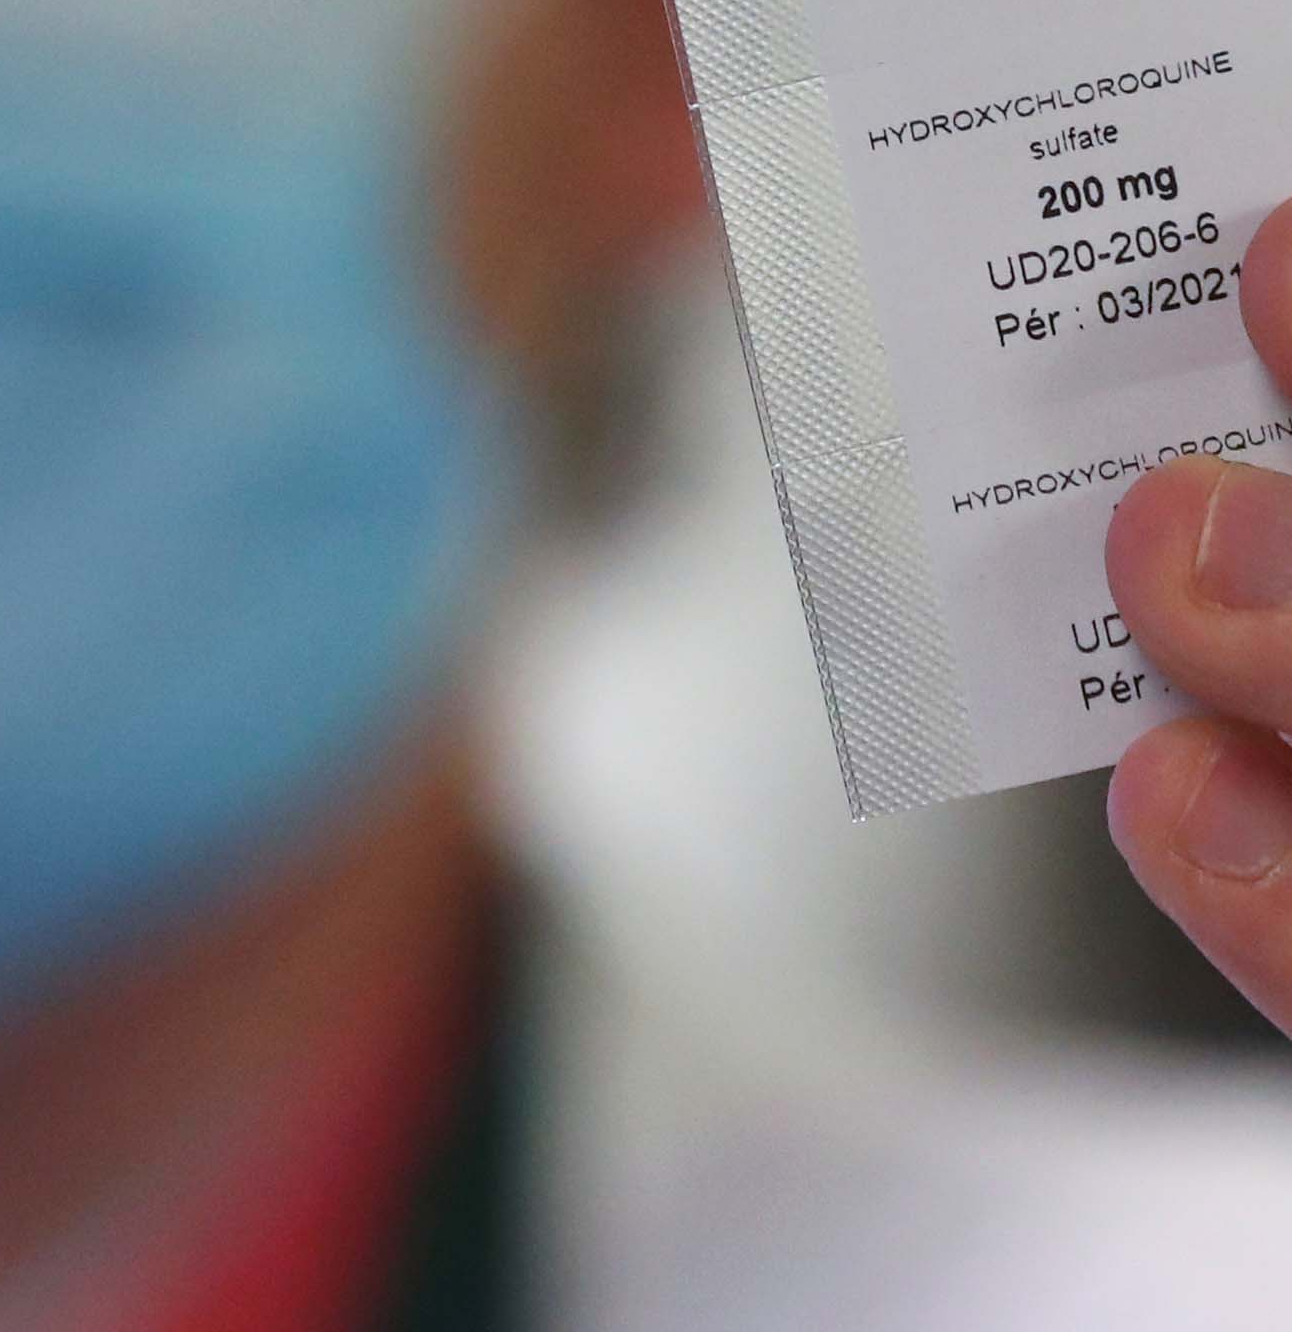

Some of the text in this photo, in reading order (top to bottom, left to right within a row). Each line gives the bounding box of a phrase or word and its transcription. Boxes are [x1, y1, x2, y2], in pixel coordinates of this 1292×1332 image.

[867, 50, 1234, 151] HYDROXYCHLOROQUINE
[1029, 123, 1119, 161] sulfate
[1037, 164, 1179, 221] 200 mg
[986, 211, 1220, 291] UD20-206-6
[994, 307, 1061, 348] Pér
[1079, 670, 1146, 712] Pér
